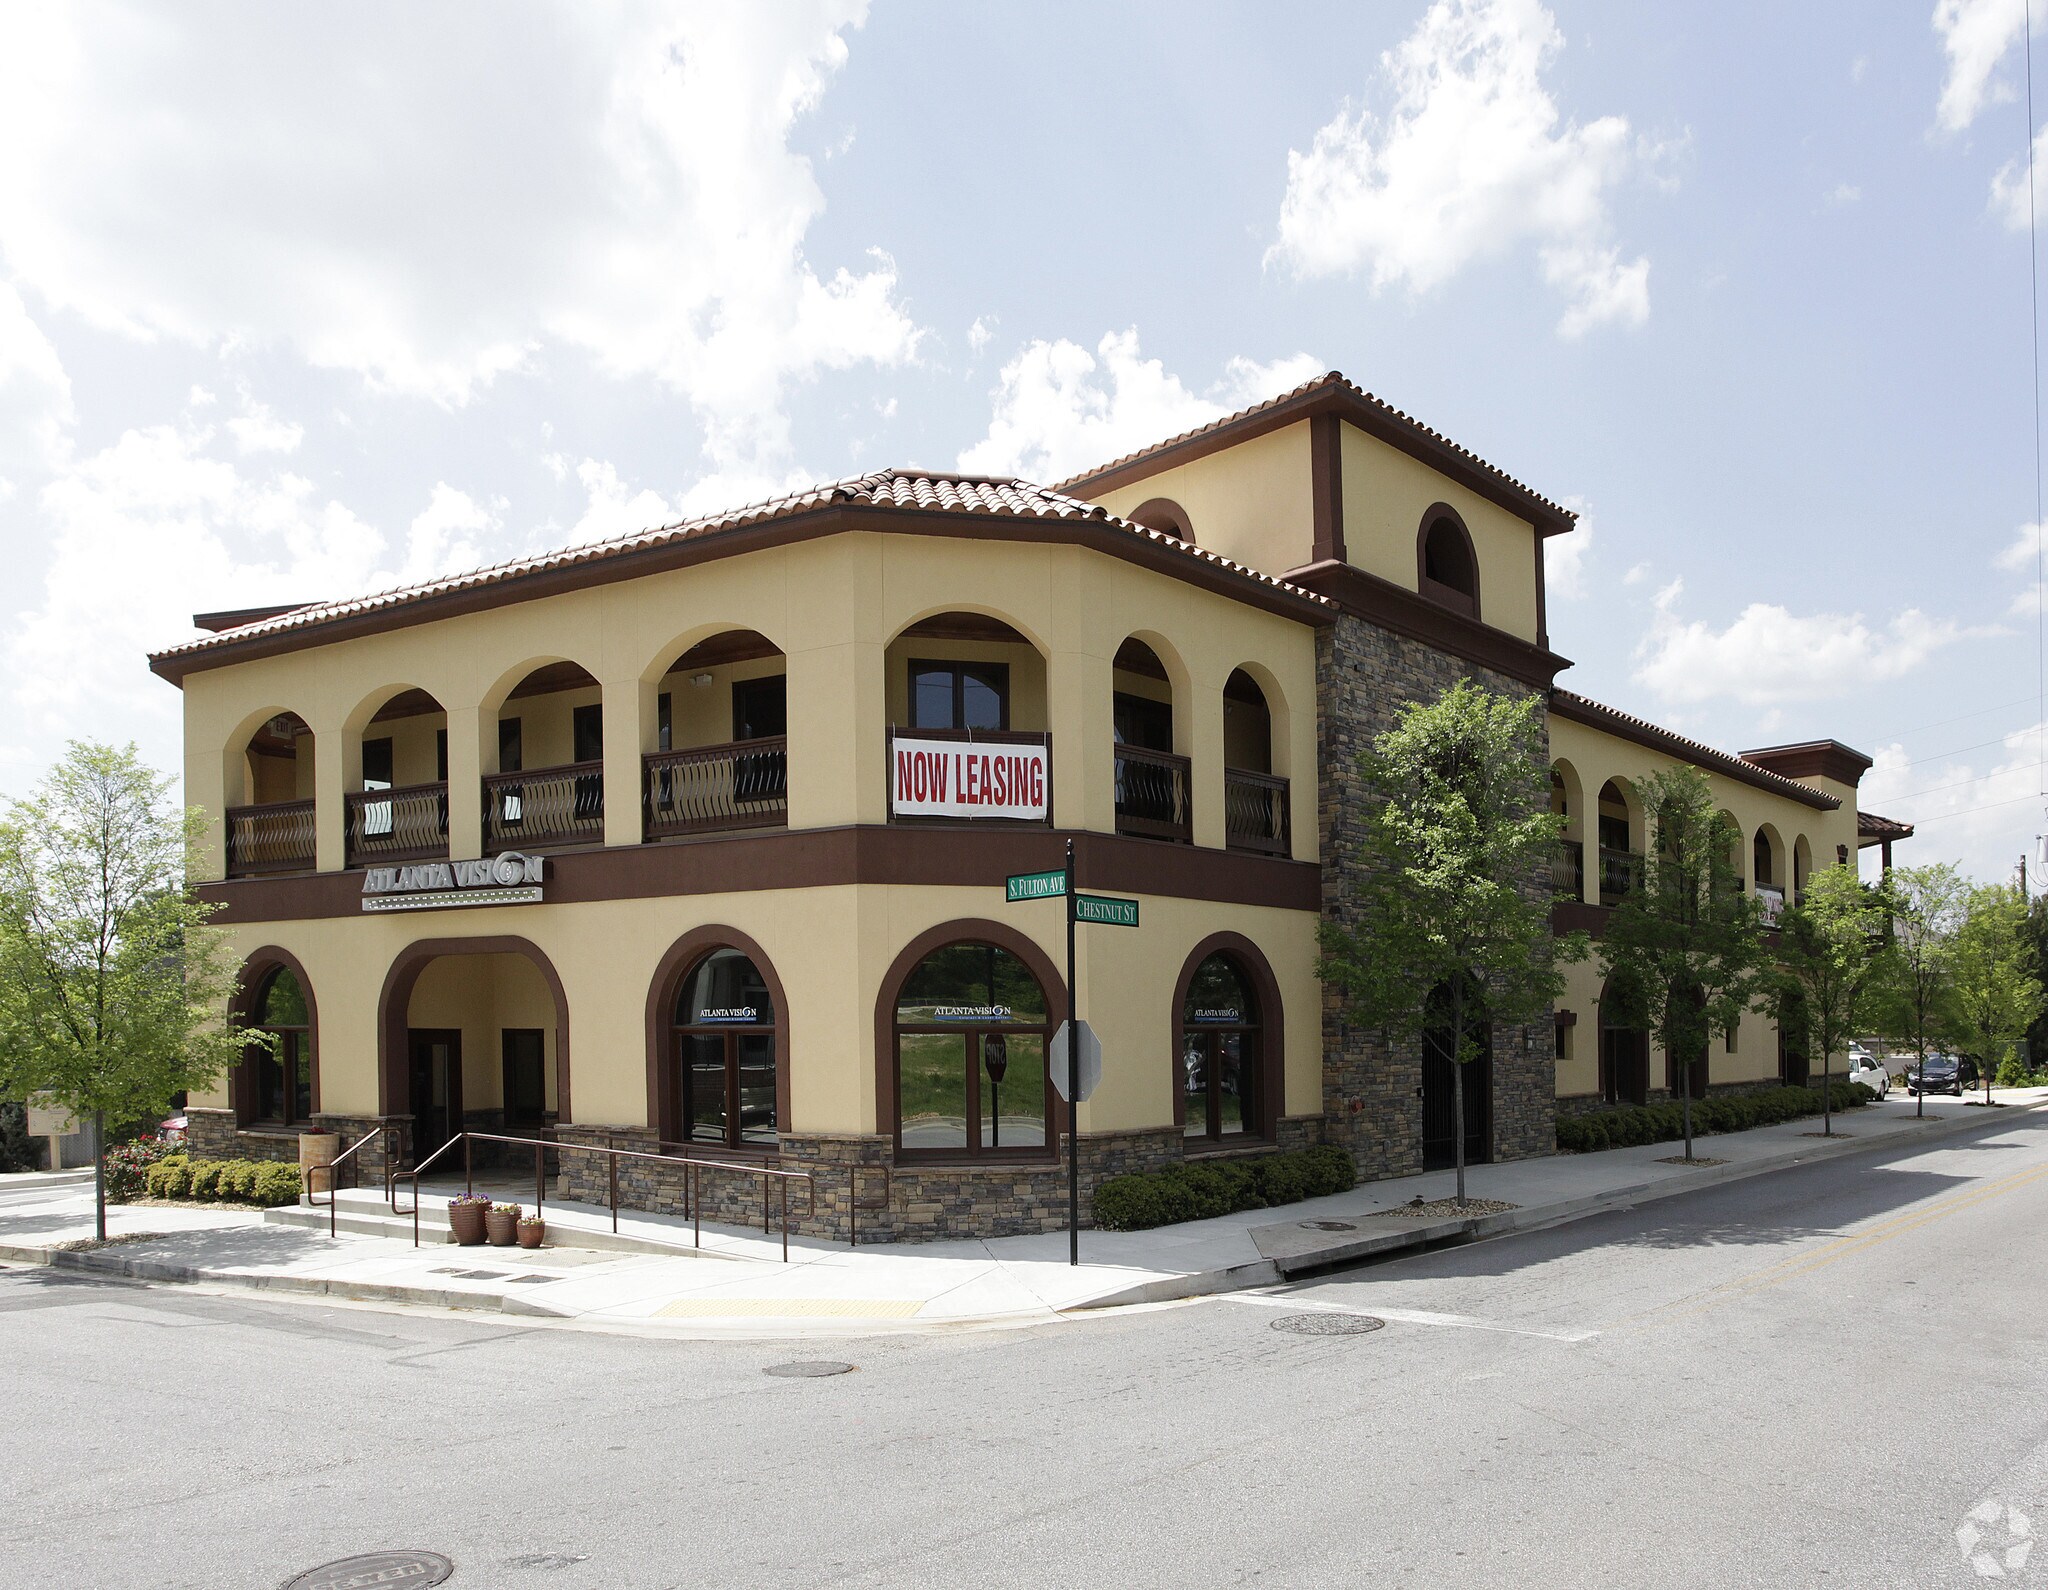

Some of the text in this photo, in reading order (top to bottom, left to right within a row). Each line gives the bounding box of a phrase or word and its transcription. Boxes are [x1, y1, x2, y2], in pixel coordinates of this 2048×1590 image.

[897, 750, 1043, 807] NOW LEASING
[362, 850, 545, 893] ATLANTA VISION
[1010, 875, 1065, 897] S. FULTON AVE
[1076, 899, 1135, 922] CHESTNUT ST
[700, 1006, 757, 1017] ATLANTA VISION
[934, 1004, 1011, 1016] ATLANTA VISION
[1194, 1008, 1239, 1017] ATLANTA VISION
